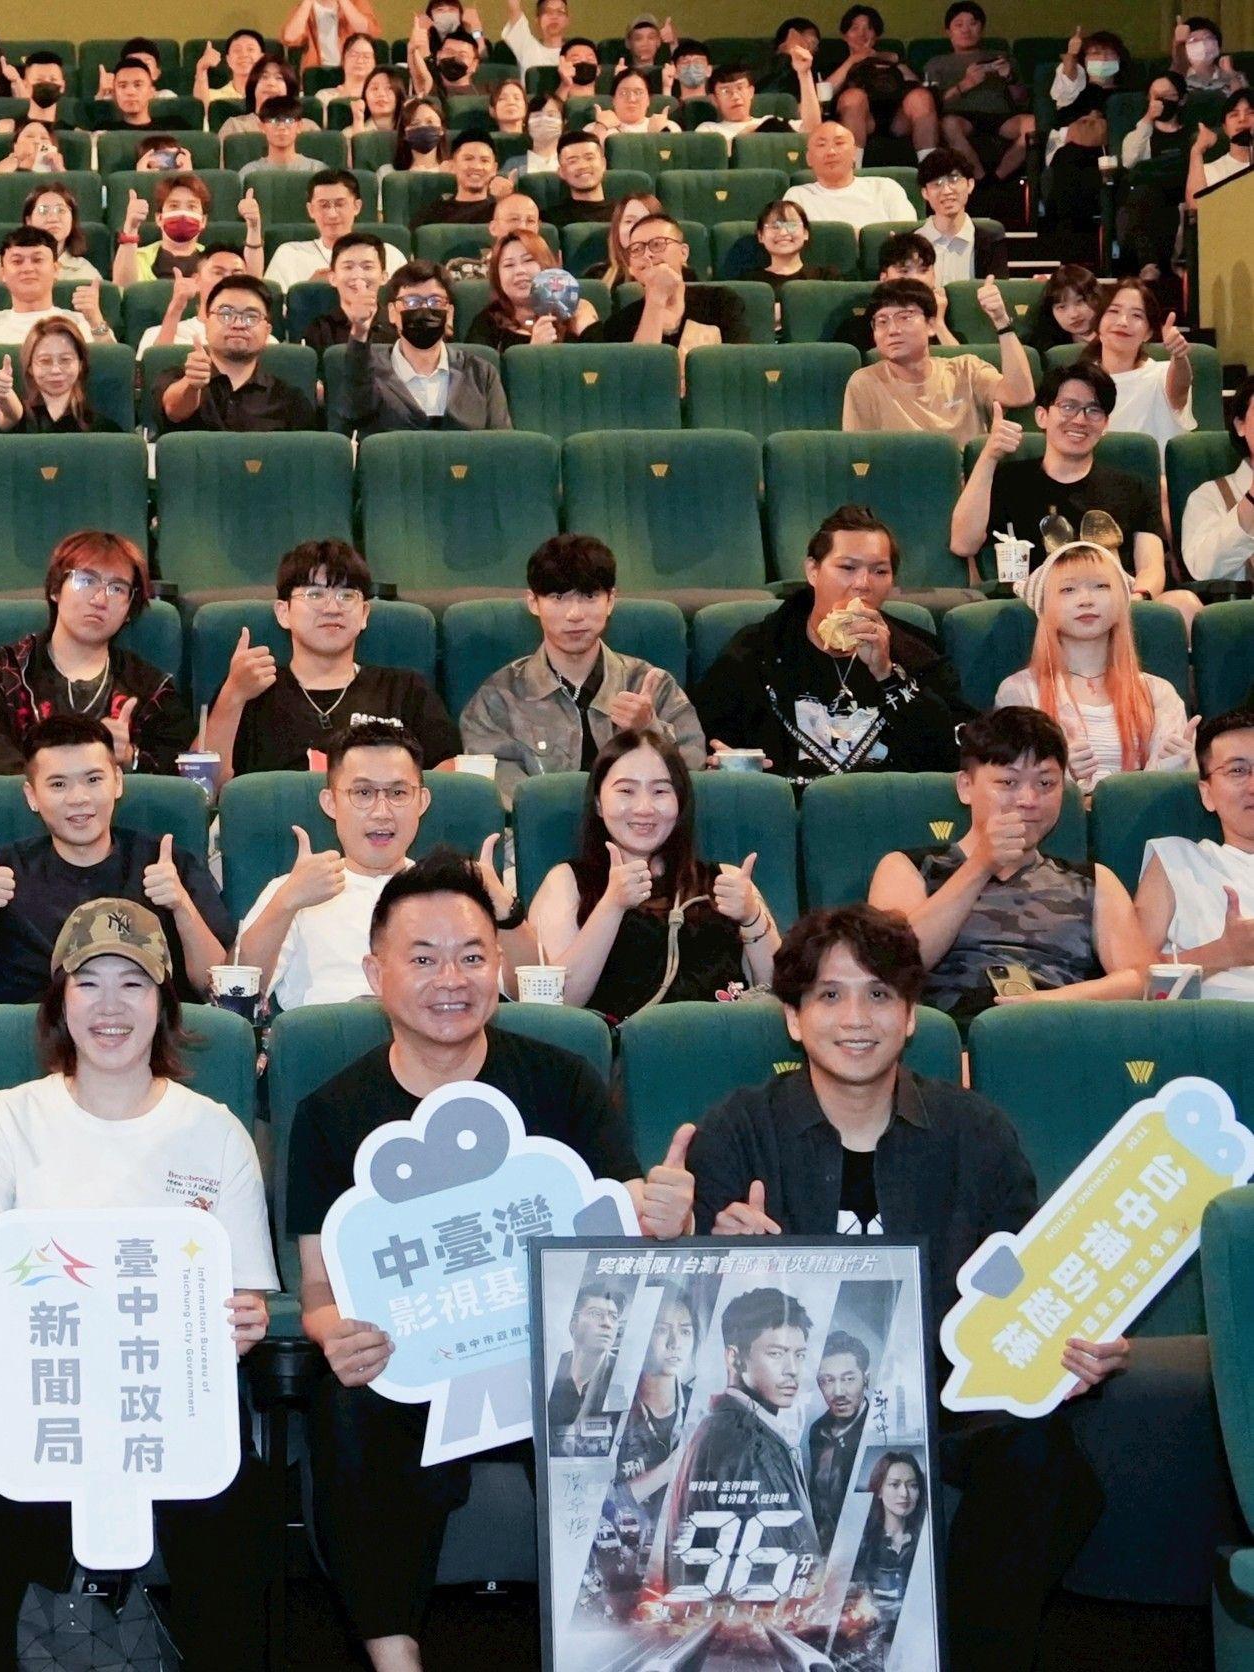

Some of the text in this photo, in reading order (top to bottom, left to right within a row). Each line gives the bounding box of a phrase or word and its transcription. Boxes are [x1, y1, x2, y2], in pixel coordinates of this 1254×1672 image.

[372, 1194, 554, 1288] 中臺灣
[182, 1268, 192, 1318] Taichung
[198, 1267, 207, 1333] Information
[29, 1301, 83, 1465] 新聞局
[115, 1238, 164, 1473] 臺中市政府
[186, 1347, 195, 1417] Government
[88, 1583, 97, 1593] 9
[487, 1581, 496, 1591] 8
